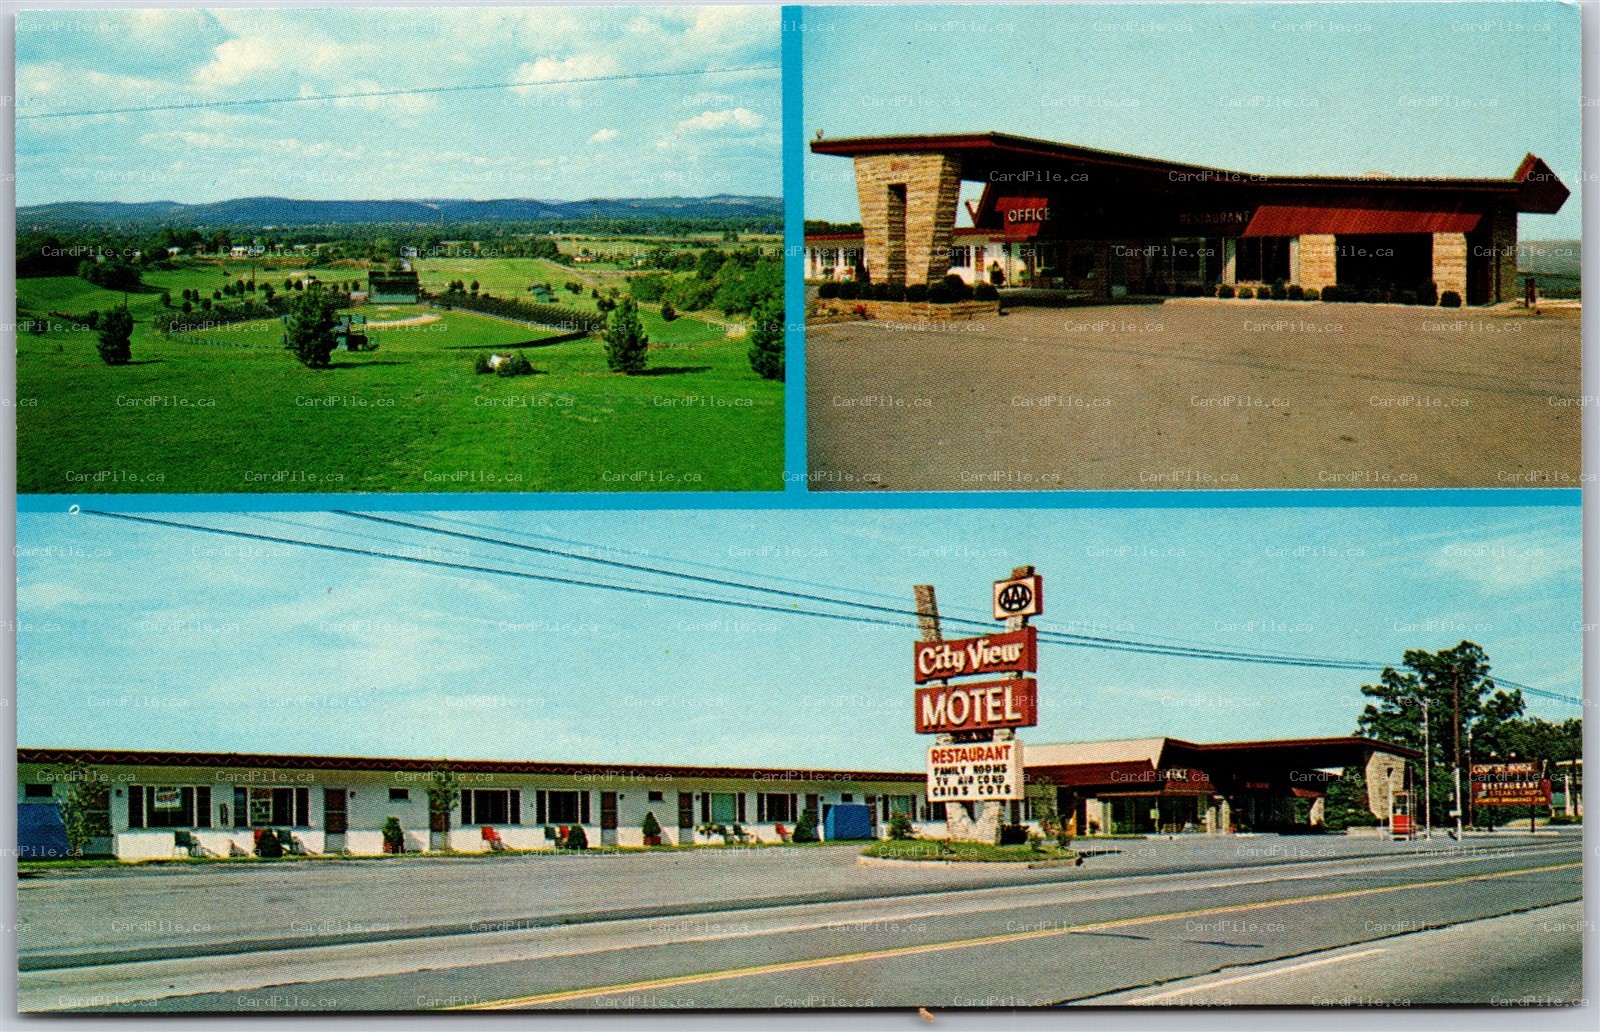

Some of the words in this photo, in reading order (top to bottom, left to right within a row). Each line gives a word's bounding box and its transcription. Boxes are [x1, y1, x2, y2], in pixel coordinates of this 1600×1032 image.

[1008, 207, 1051, 222] OFFICE
[1000, 585, 1031, 611] AAA
[918, 645, 965, 674] City
[967, 639, 1024, 670] View
[922, 685, 1023, 728] MOTEL
[931, 745, 1011, 763] RESTAURANT
[934, 765, 966, 775] FAMILY
[973, 764, 1007, 774] ROOMS
[936, 776, 948, 786] TV
[958, 776, 974, 785] AIR
[977, 775, 1005, 785] COND
[932, 786, 969, 797] CRIBS
[978, 784, 1011, 795] COTS
